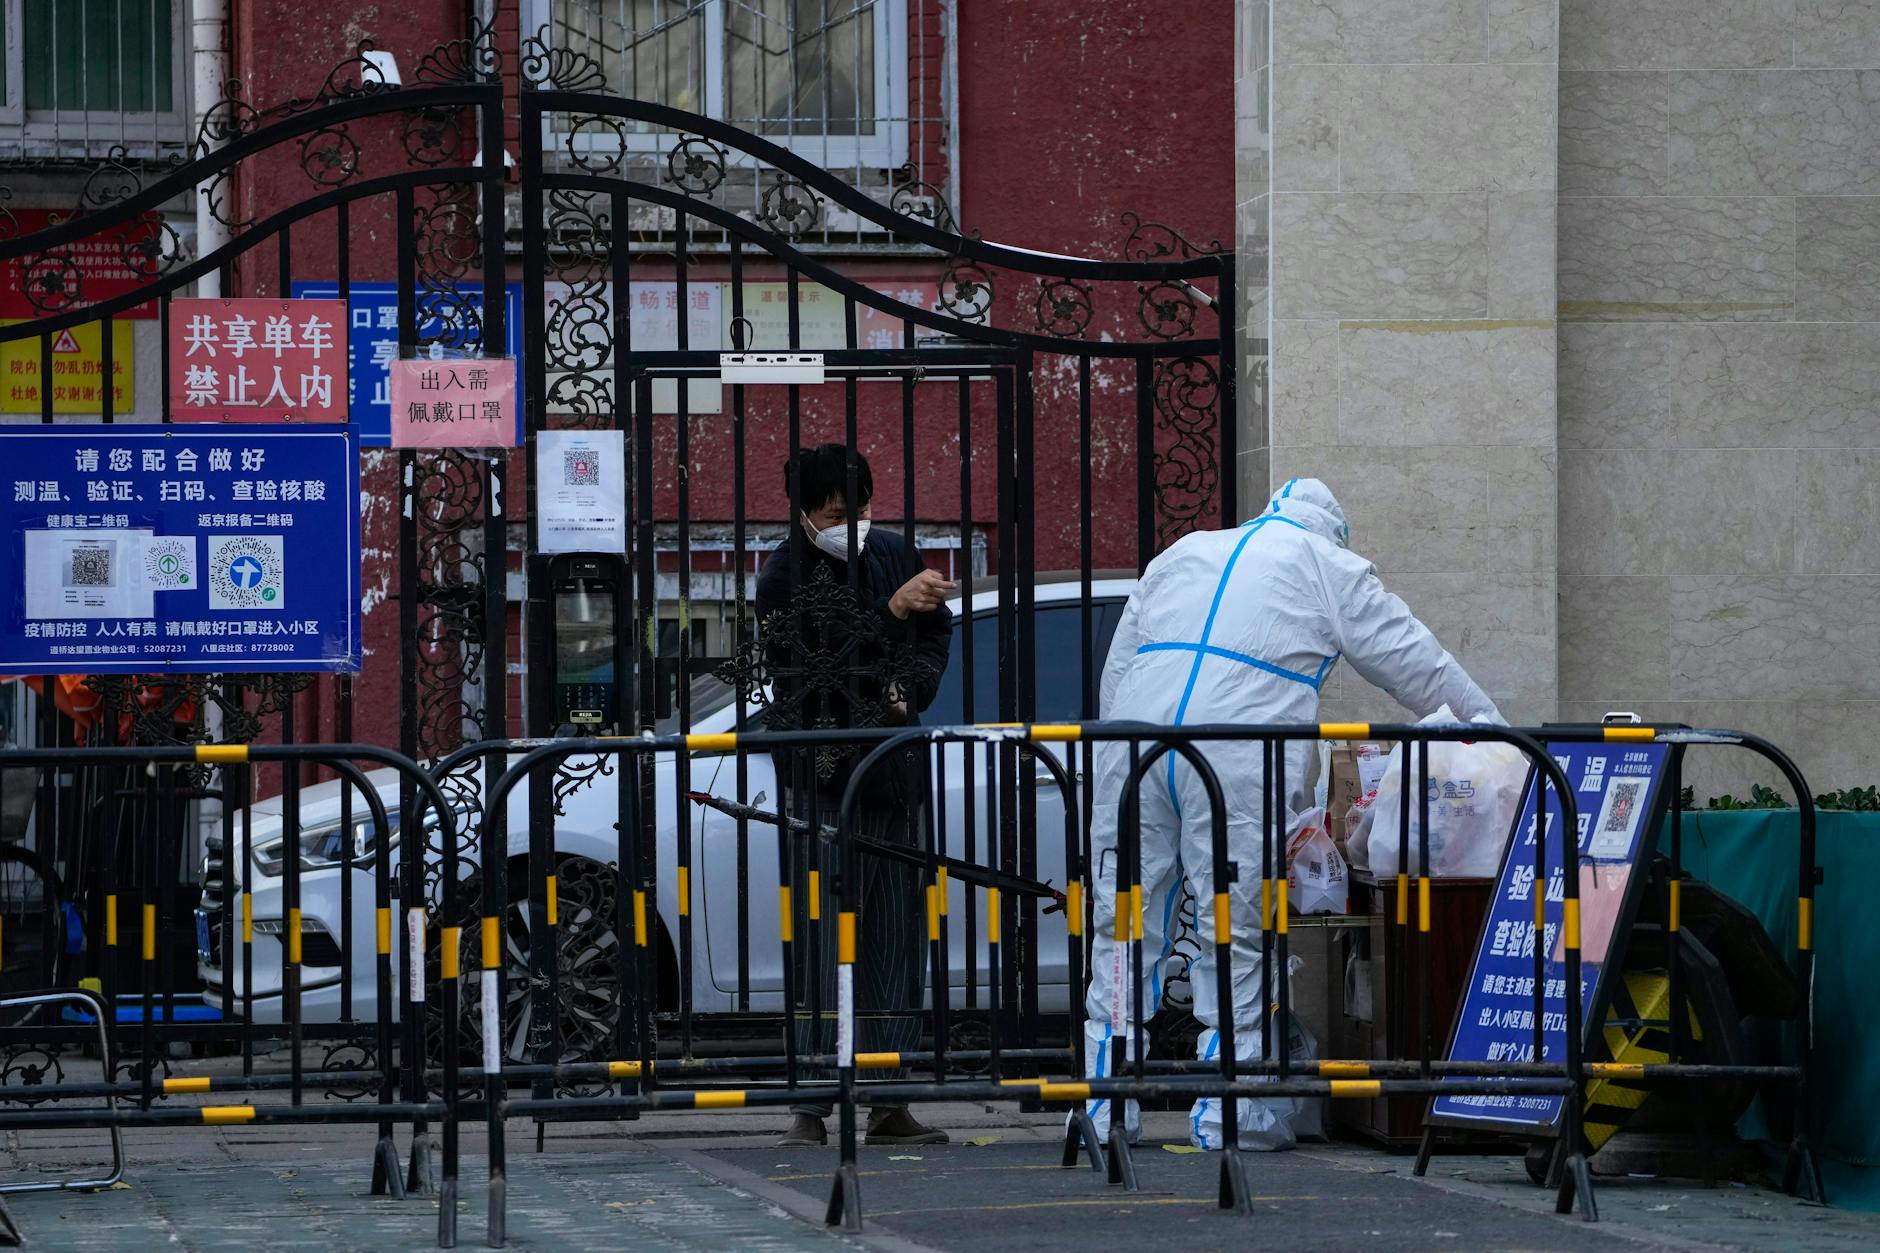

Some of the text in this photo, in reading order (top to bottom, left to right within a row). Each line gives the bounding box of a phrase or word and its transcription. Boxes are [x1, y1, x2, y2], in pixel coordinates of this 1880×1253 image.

[184, 314, 333, 359] 共享单车
[10, 360, 123, 374] 院内勿乱扔头
[421, 369, 489, 390] 出入需
[11, 386, 123, 400] 杜绝灾谢谢作
[408, 401, 502, 423] 佩戴口罩
[75, 448, 266, 472] 请您配合做好
[46, 514, 129, 528] 健康宝二维码
[198, 513, 293, 527] 返京报备二维码
[24, 620, 319, 637] 疫情防控 人人有责 请佩戴好口罩进入小区
[1443, 780, 1475, 799] 盒马
[1481, 974, 1588, 998] 请您主动配管理
